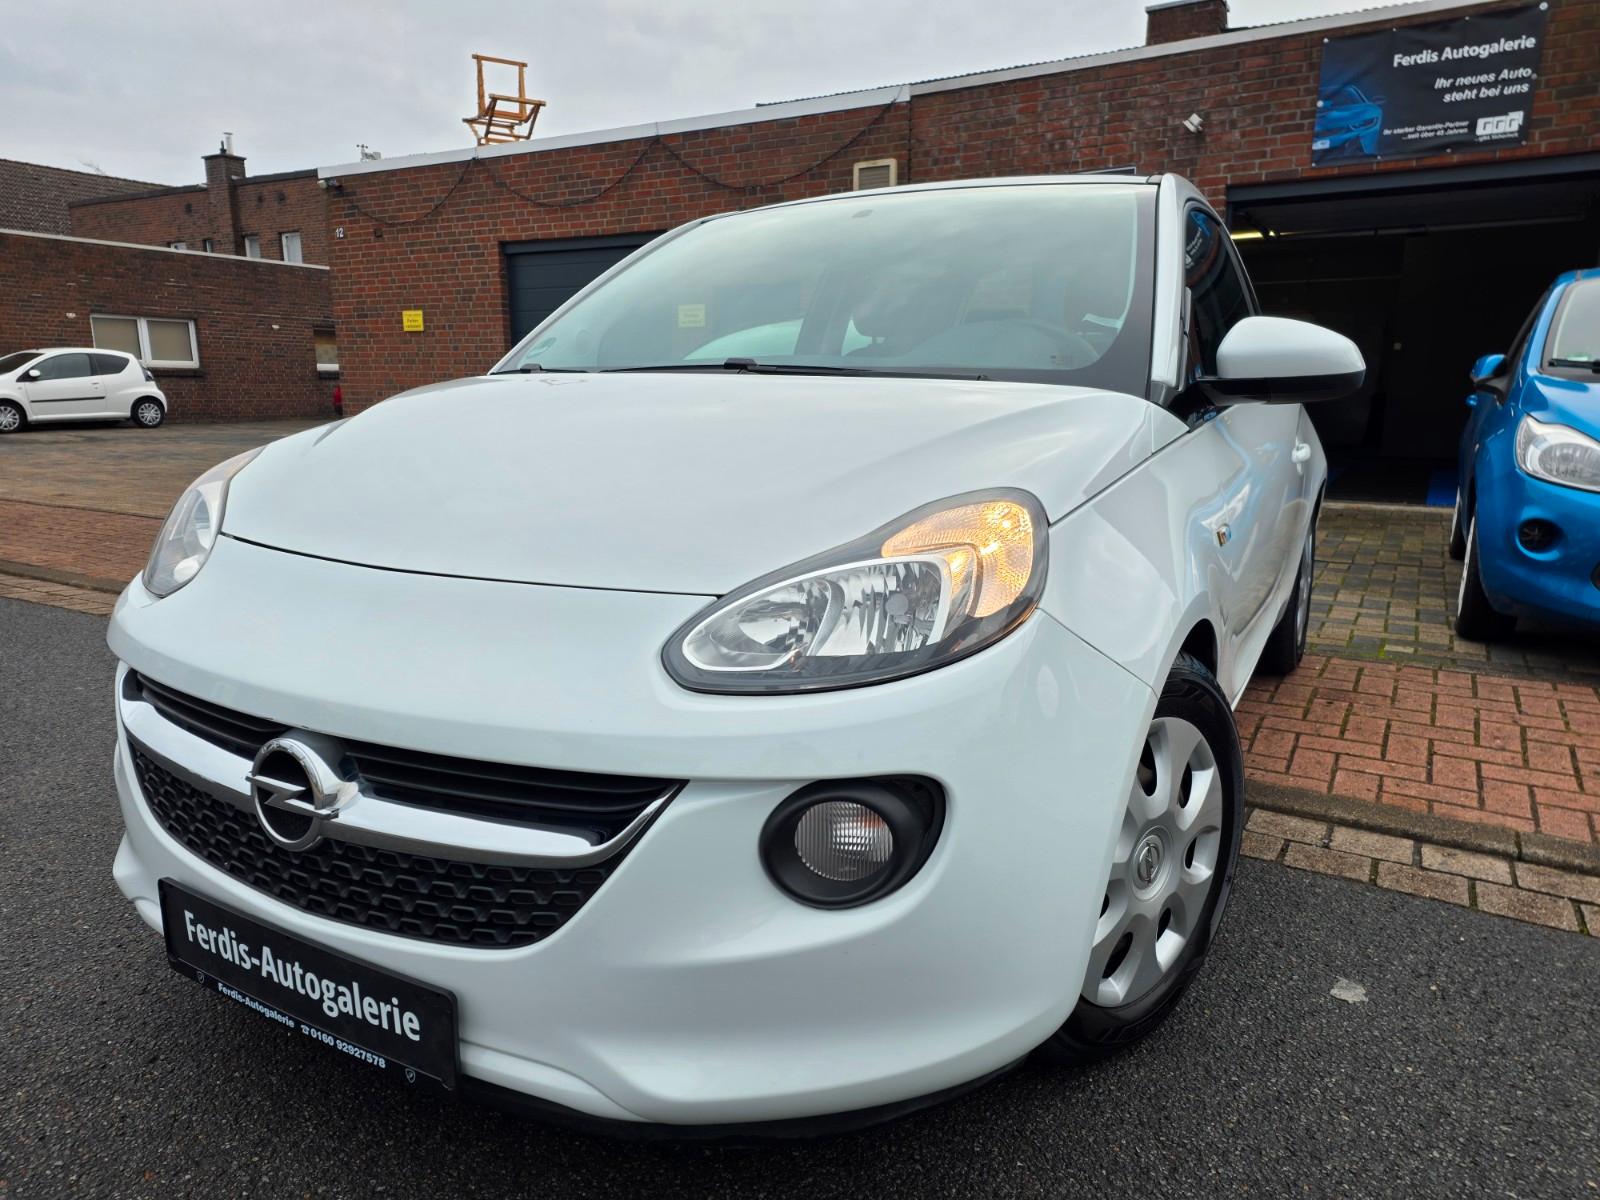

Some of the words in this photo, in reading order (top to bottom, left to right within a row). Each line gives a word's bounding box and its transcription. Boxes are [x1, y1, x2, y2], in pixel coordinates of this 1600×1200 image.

[1393, 49, 1439, 67] Ferdis
[1441, 35, 1536, 61] Autogalerie
[1434, 77, 1453, 89] Ihr
[1455, 72, 1496, 87] neues
[1443, 90, 1478, 103] steht
[1479, 85, 1501, 99] bei
[1503, 83, 1530, 96] uns
[336, 227, 344, 238] 12
[184, 910, 420, 1041] Ferdis-Autogalerie
[218, 982, 295, 1028] Ferdis-Autogalerie
